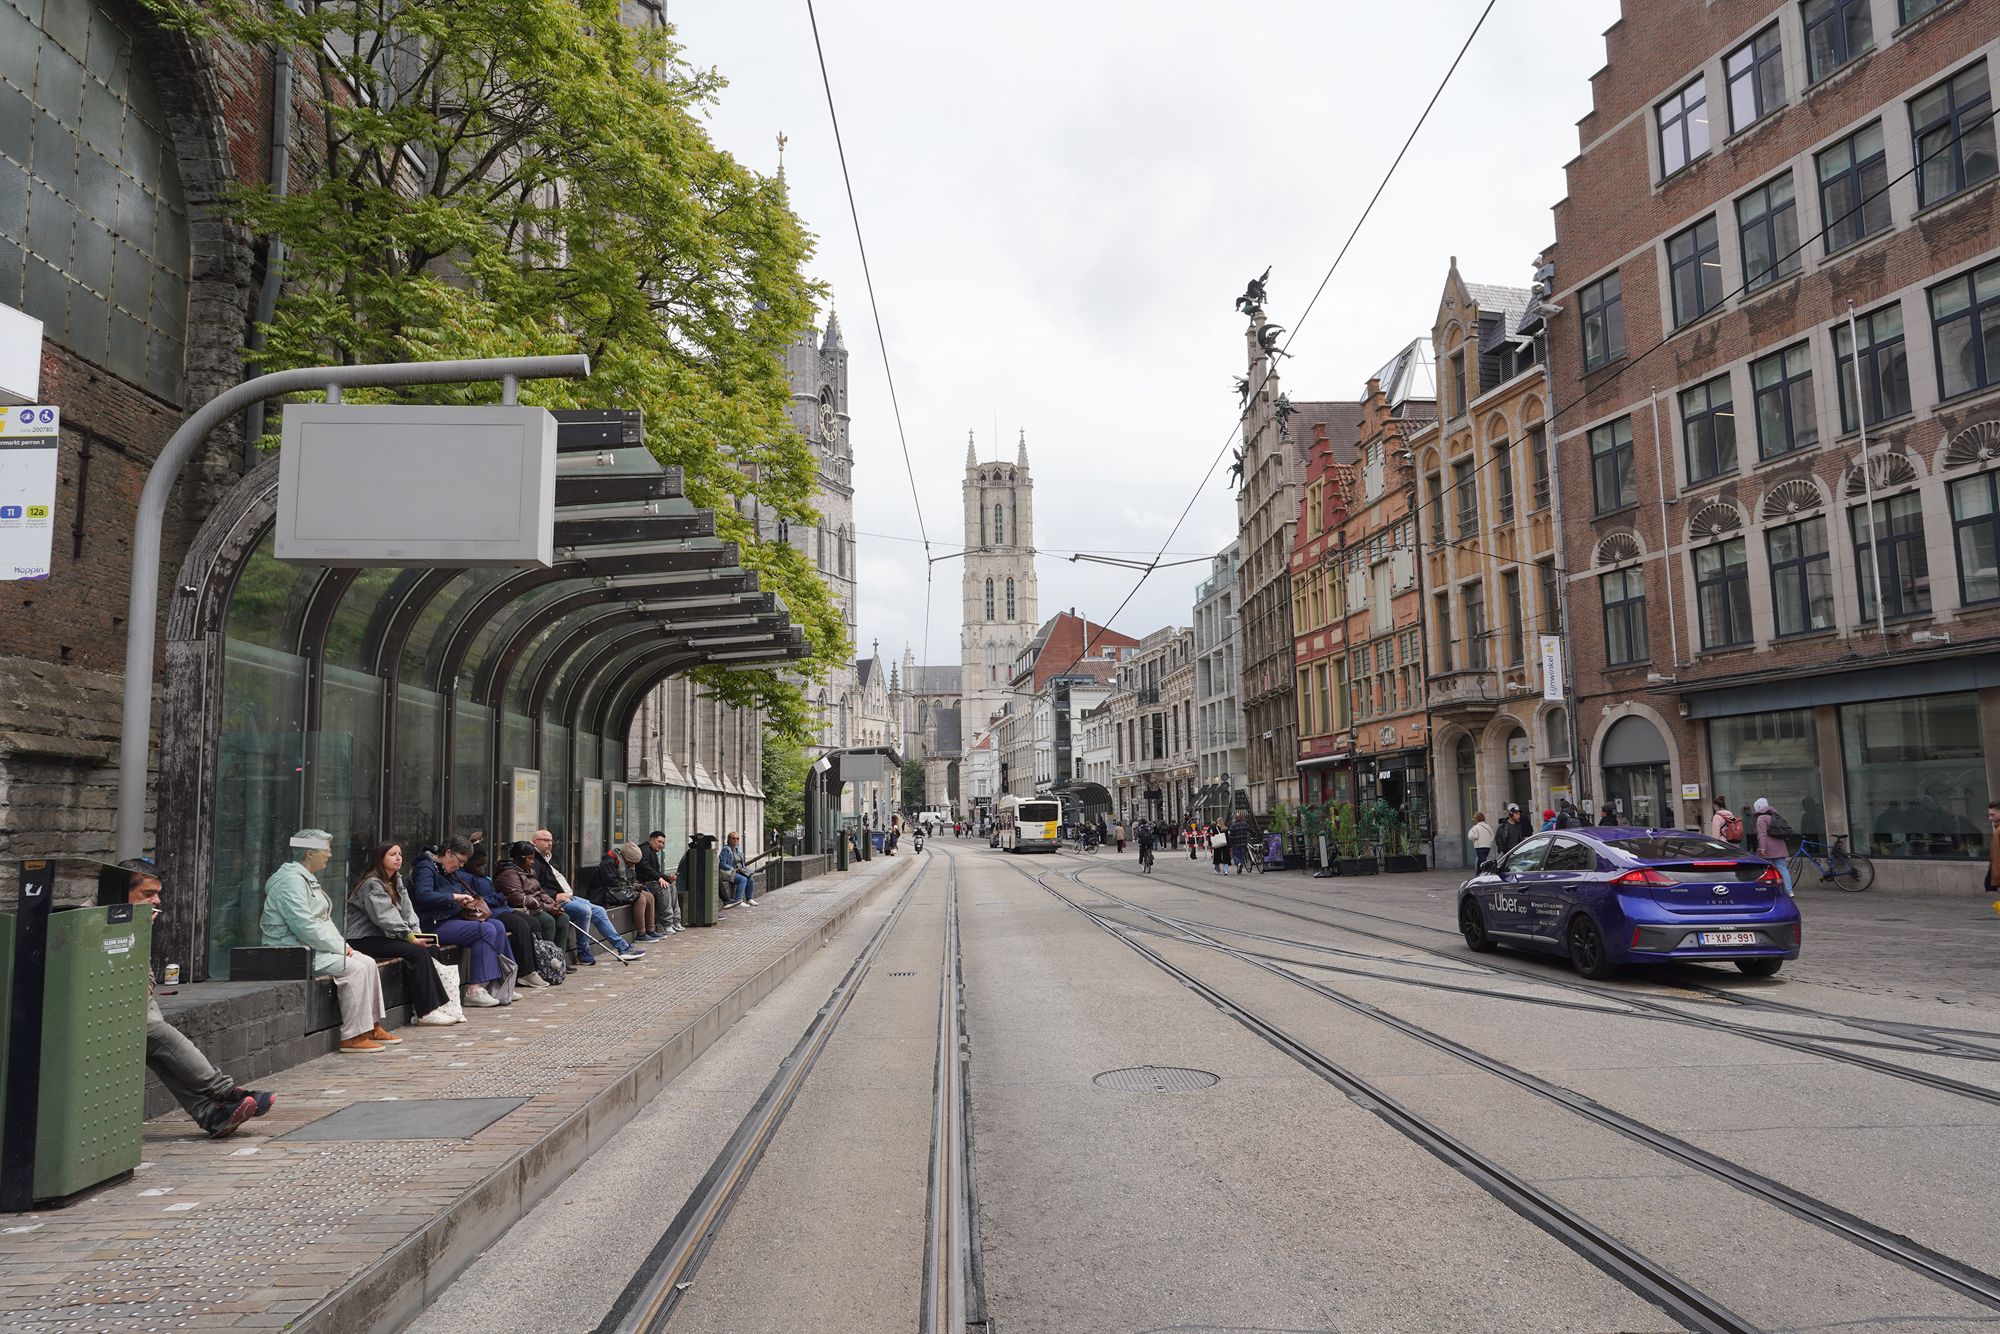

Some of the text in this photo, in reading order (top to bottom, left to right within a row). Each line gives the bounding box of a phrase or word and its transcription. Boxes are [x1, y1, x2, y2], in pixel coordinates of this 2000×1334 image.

[7, 508, 15, 516] 11
[30, 508, 44, 516] 12a
[1547, 655, 1558, 696] Lijnwinkel
[1379, 770, 1391, 779] NUB
[1495, 893, 1517, 912] Uber
[1518, 906, 1527, 914] app
